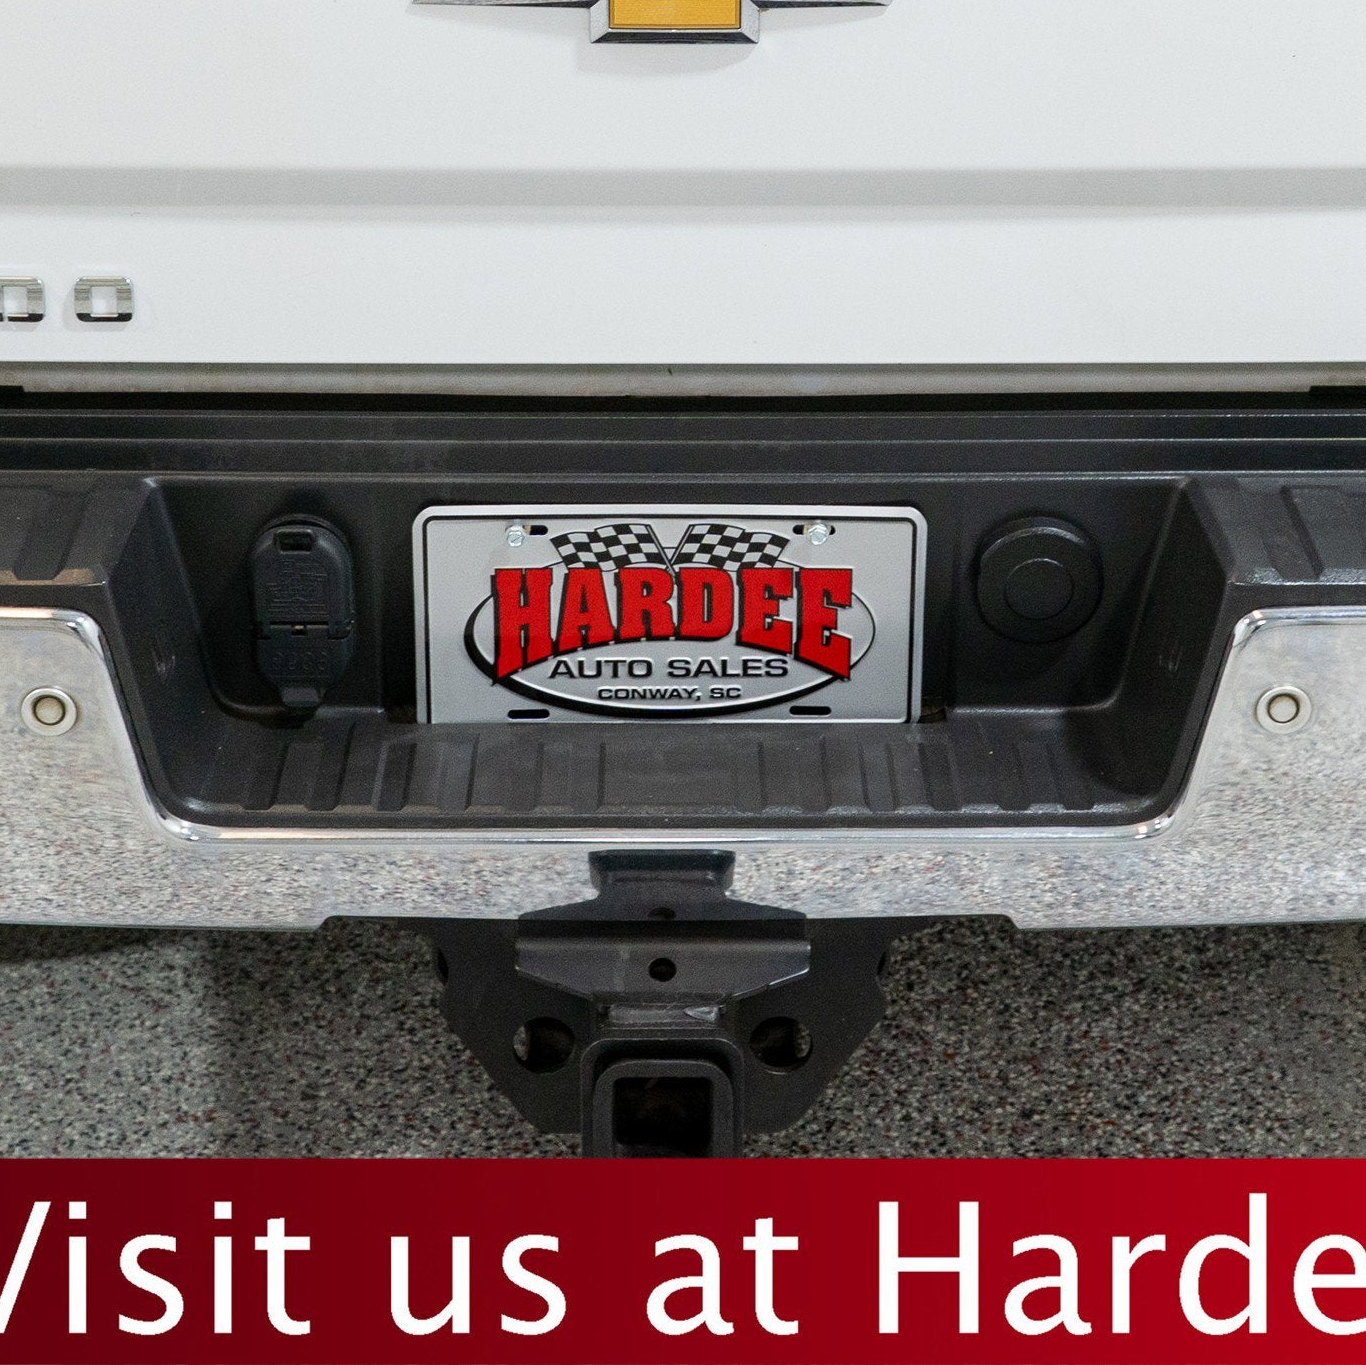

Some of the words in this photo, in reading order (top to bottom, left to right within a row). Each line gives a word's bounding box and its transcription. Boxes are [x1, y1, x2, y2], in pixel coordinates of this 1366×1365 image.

[492, 567, 853, 680] HARDEE
[549, 658, 652, 679] AUTO
[667, 657, 789, 678] SALES
[597, 686, 702, 702] CONWAY,
[710, 686, 742, 700] SC
